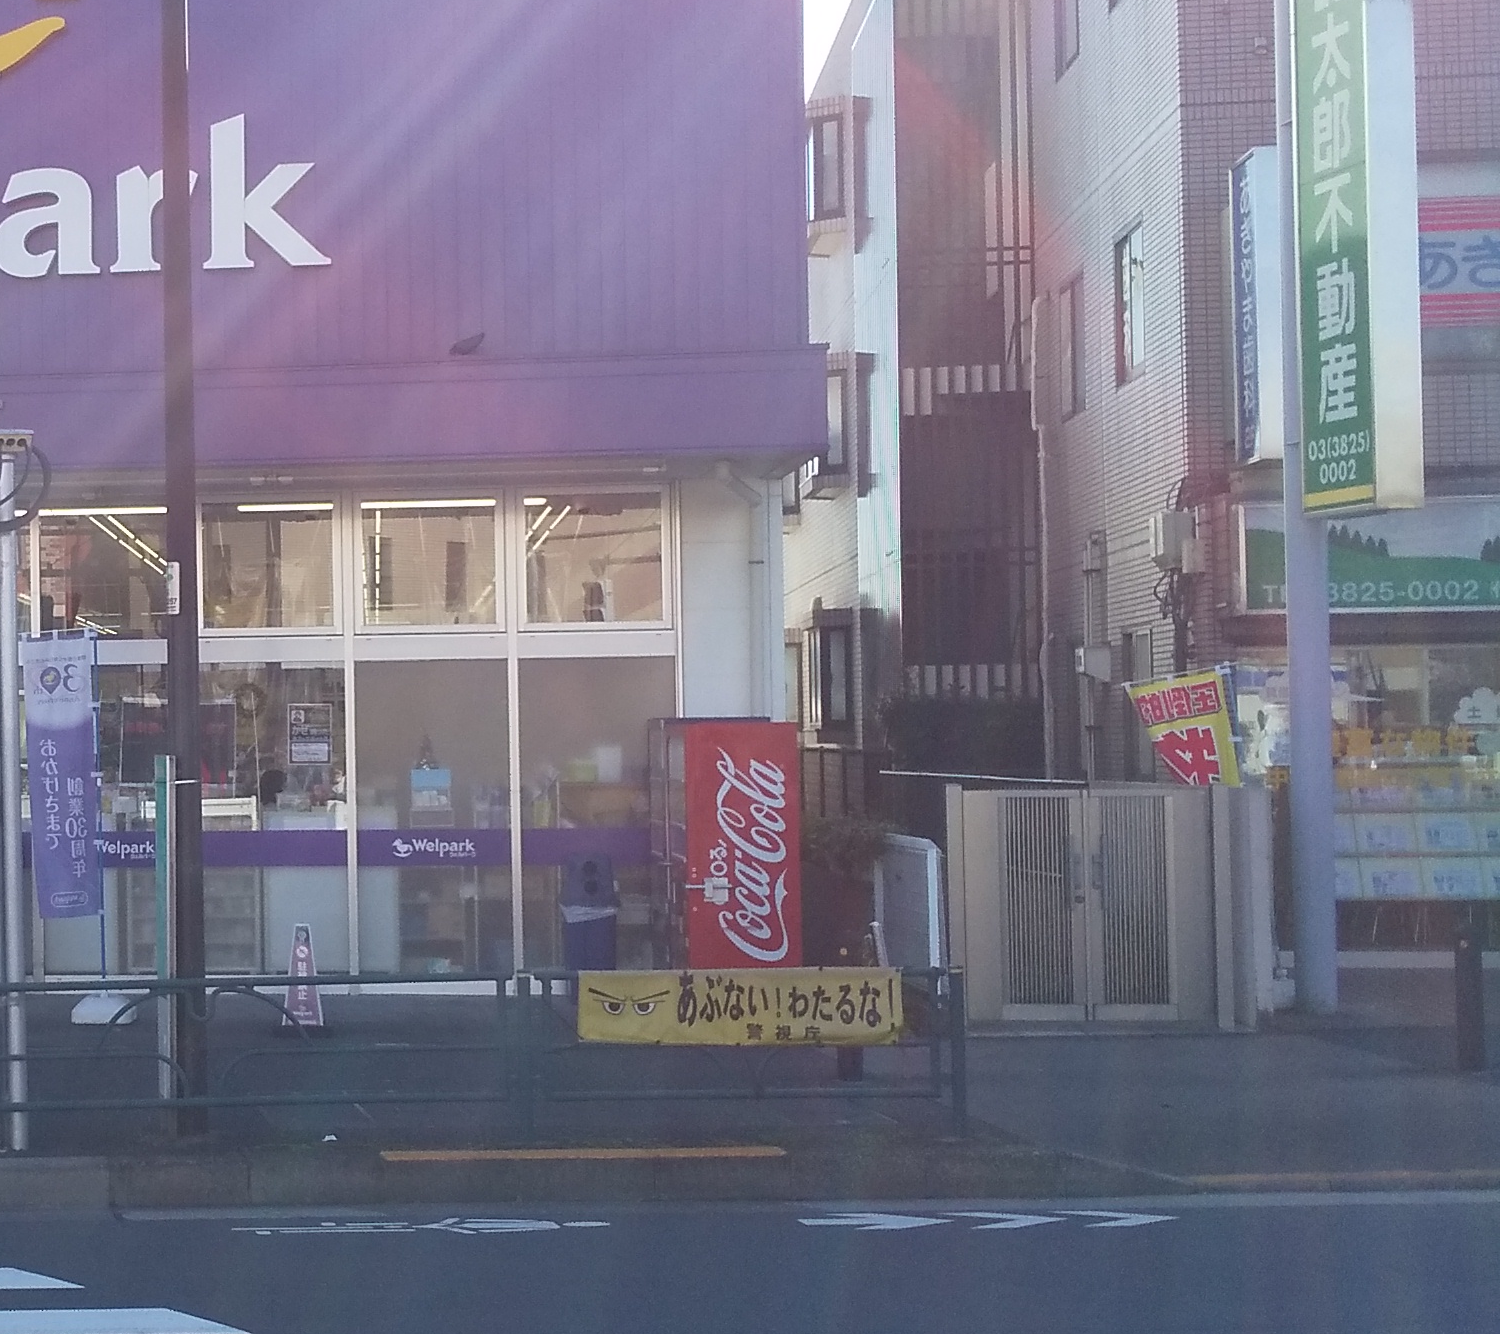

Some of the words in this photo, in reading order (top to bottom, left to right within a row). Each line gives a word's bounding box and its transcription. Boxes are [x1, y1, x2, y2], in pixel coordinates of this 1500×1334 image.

[1308, 430, 1370, 462] 03(3825)
[1319, 459, 1357, 485] 0002
[100, 840, 155, 859] Welpark
[412, 838, 475, 857] Welpark
[716, 747, 788, 961] Coca-Cola
[746, 1023, 821, 1042] 警視庁
